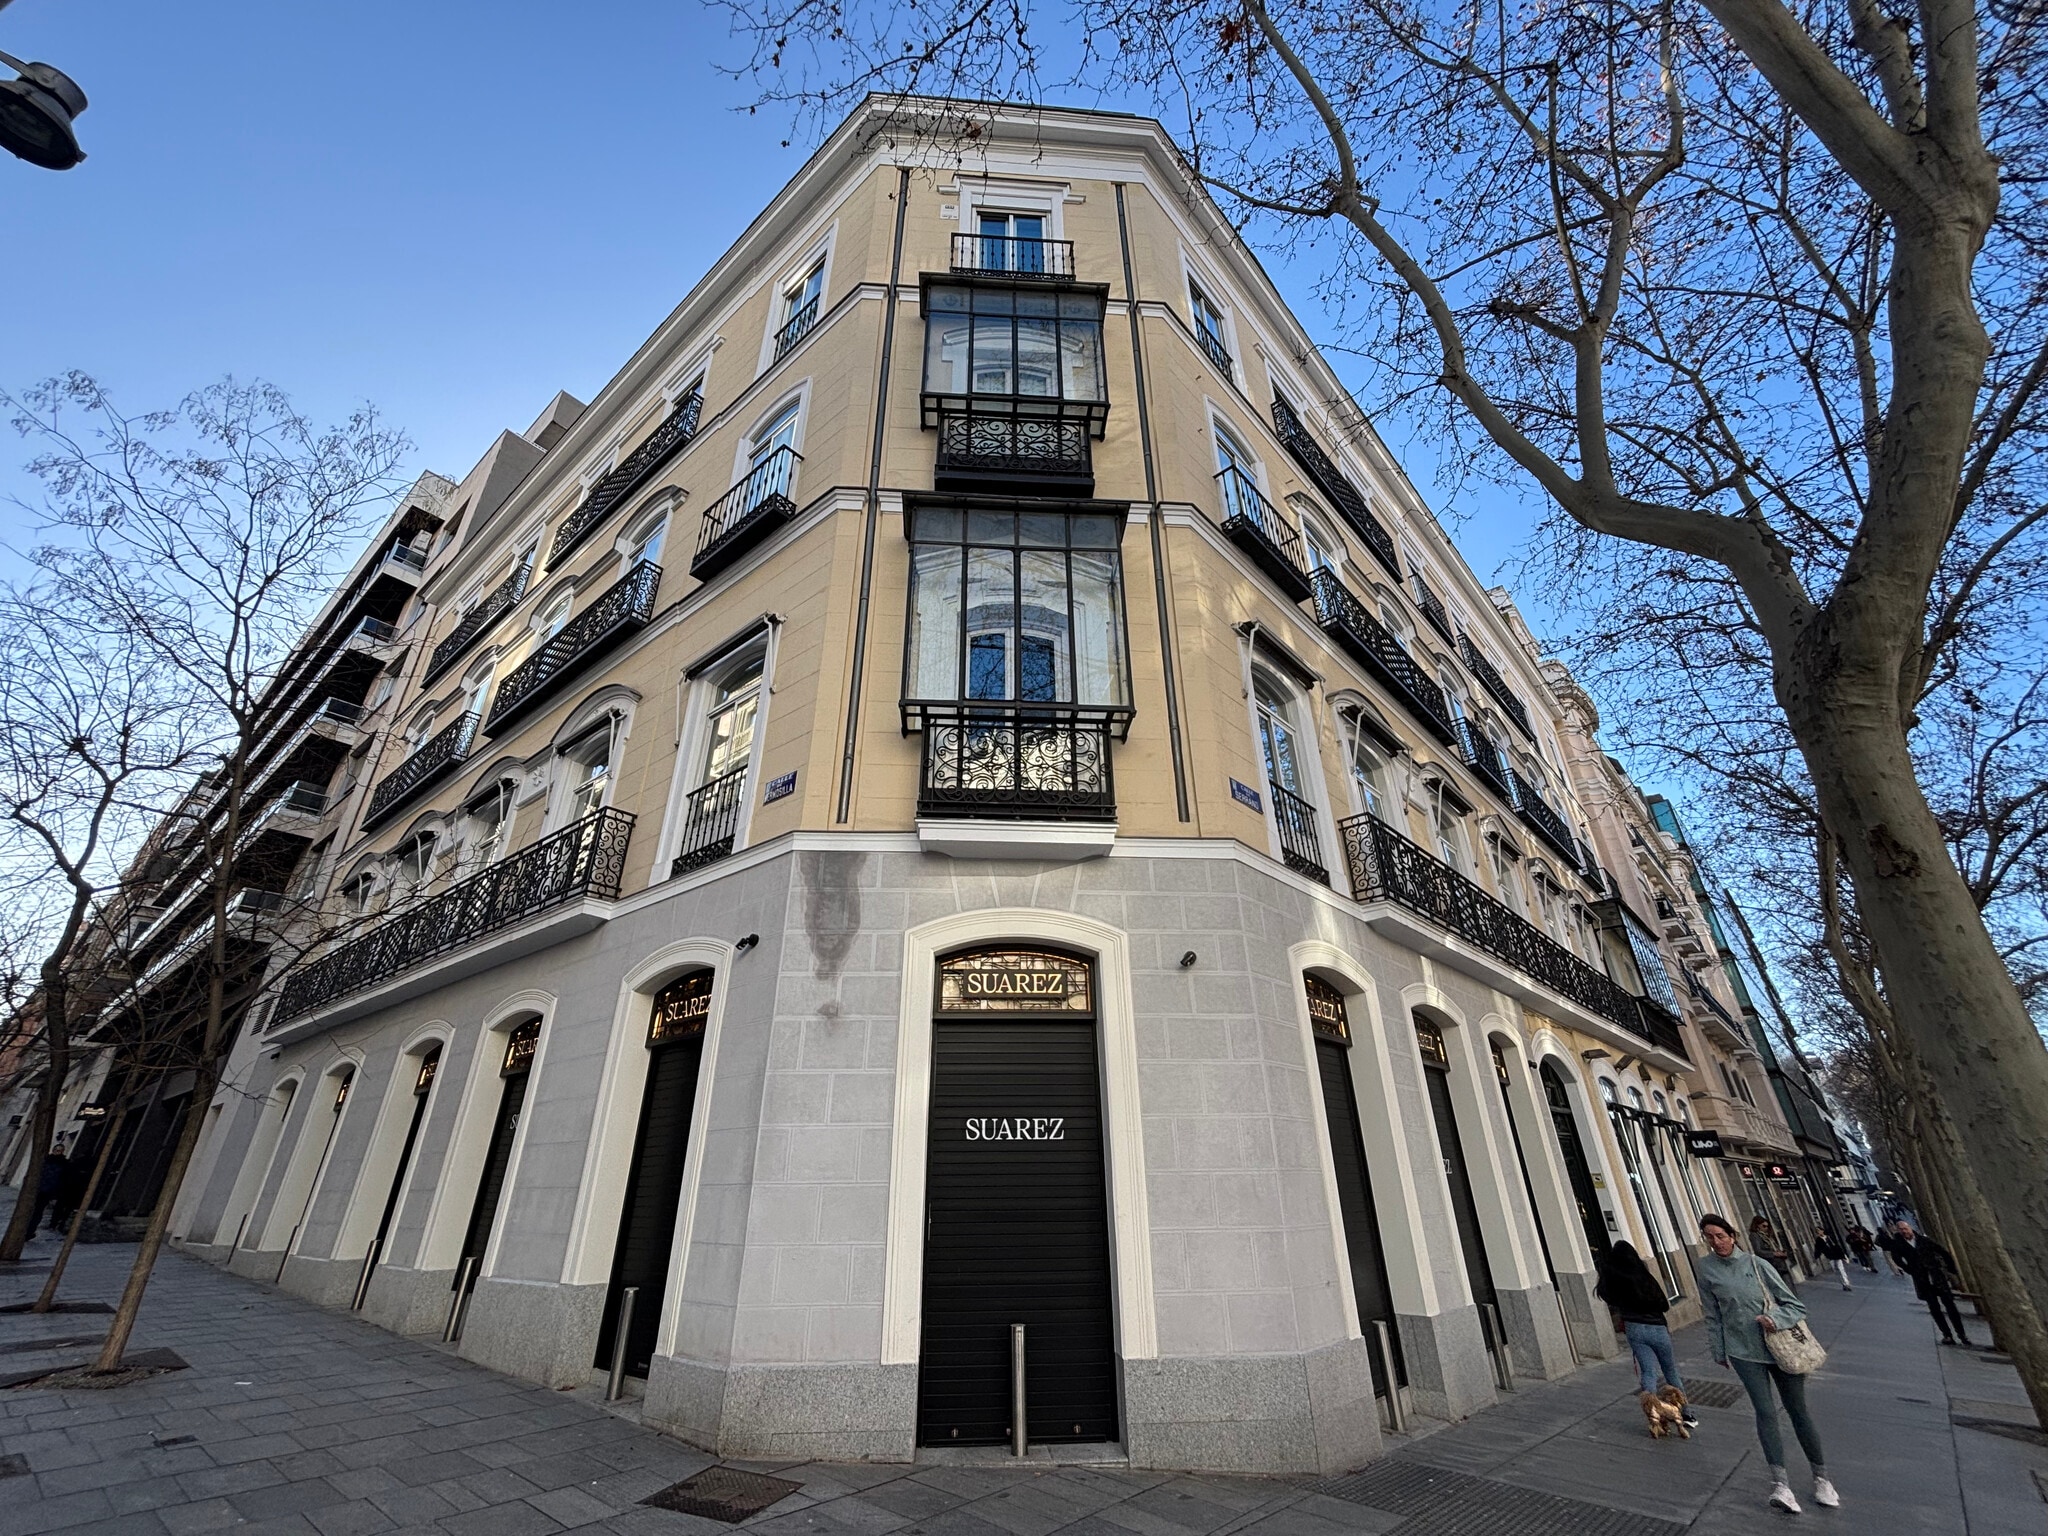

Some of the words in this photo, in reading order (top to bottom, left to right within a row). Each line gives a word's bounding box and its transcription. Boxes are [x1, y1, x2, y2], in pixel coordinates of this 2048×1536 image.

[772, 773, 794, 786] CALLE
[967, 973, 1063, 995] SUAREZ
[1307, 997, 1336, 1021] AREZ
[965, 1117, 1064, 1141] SUAREZ
